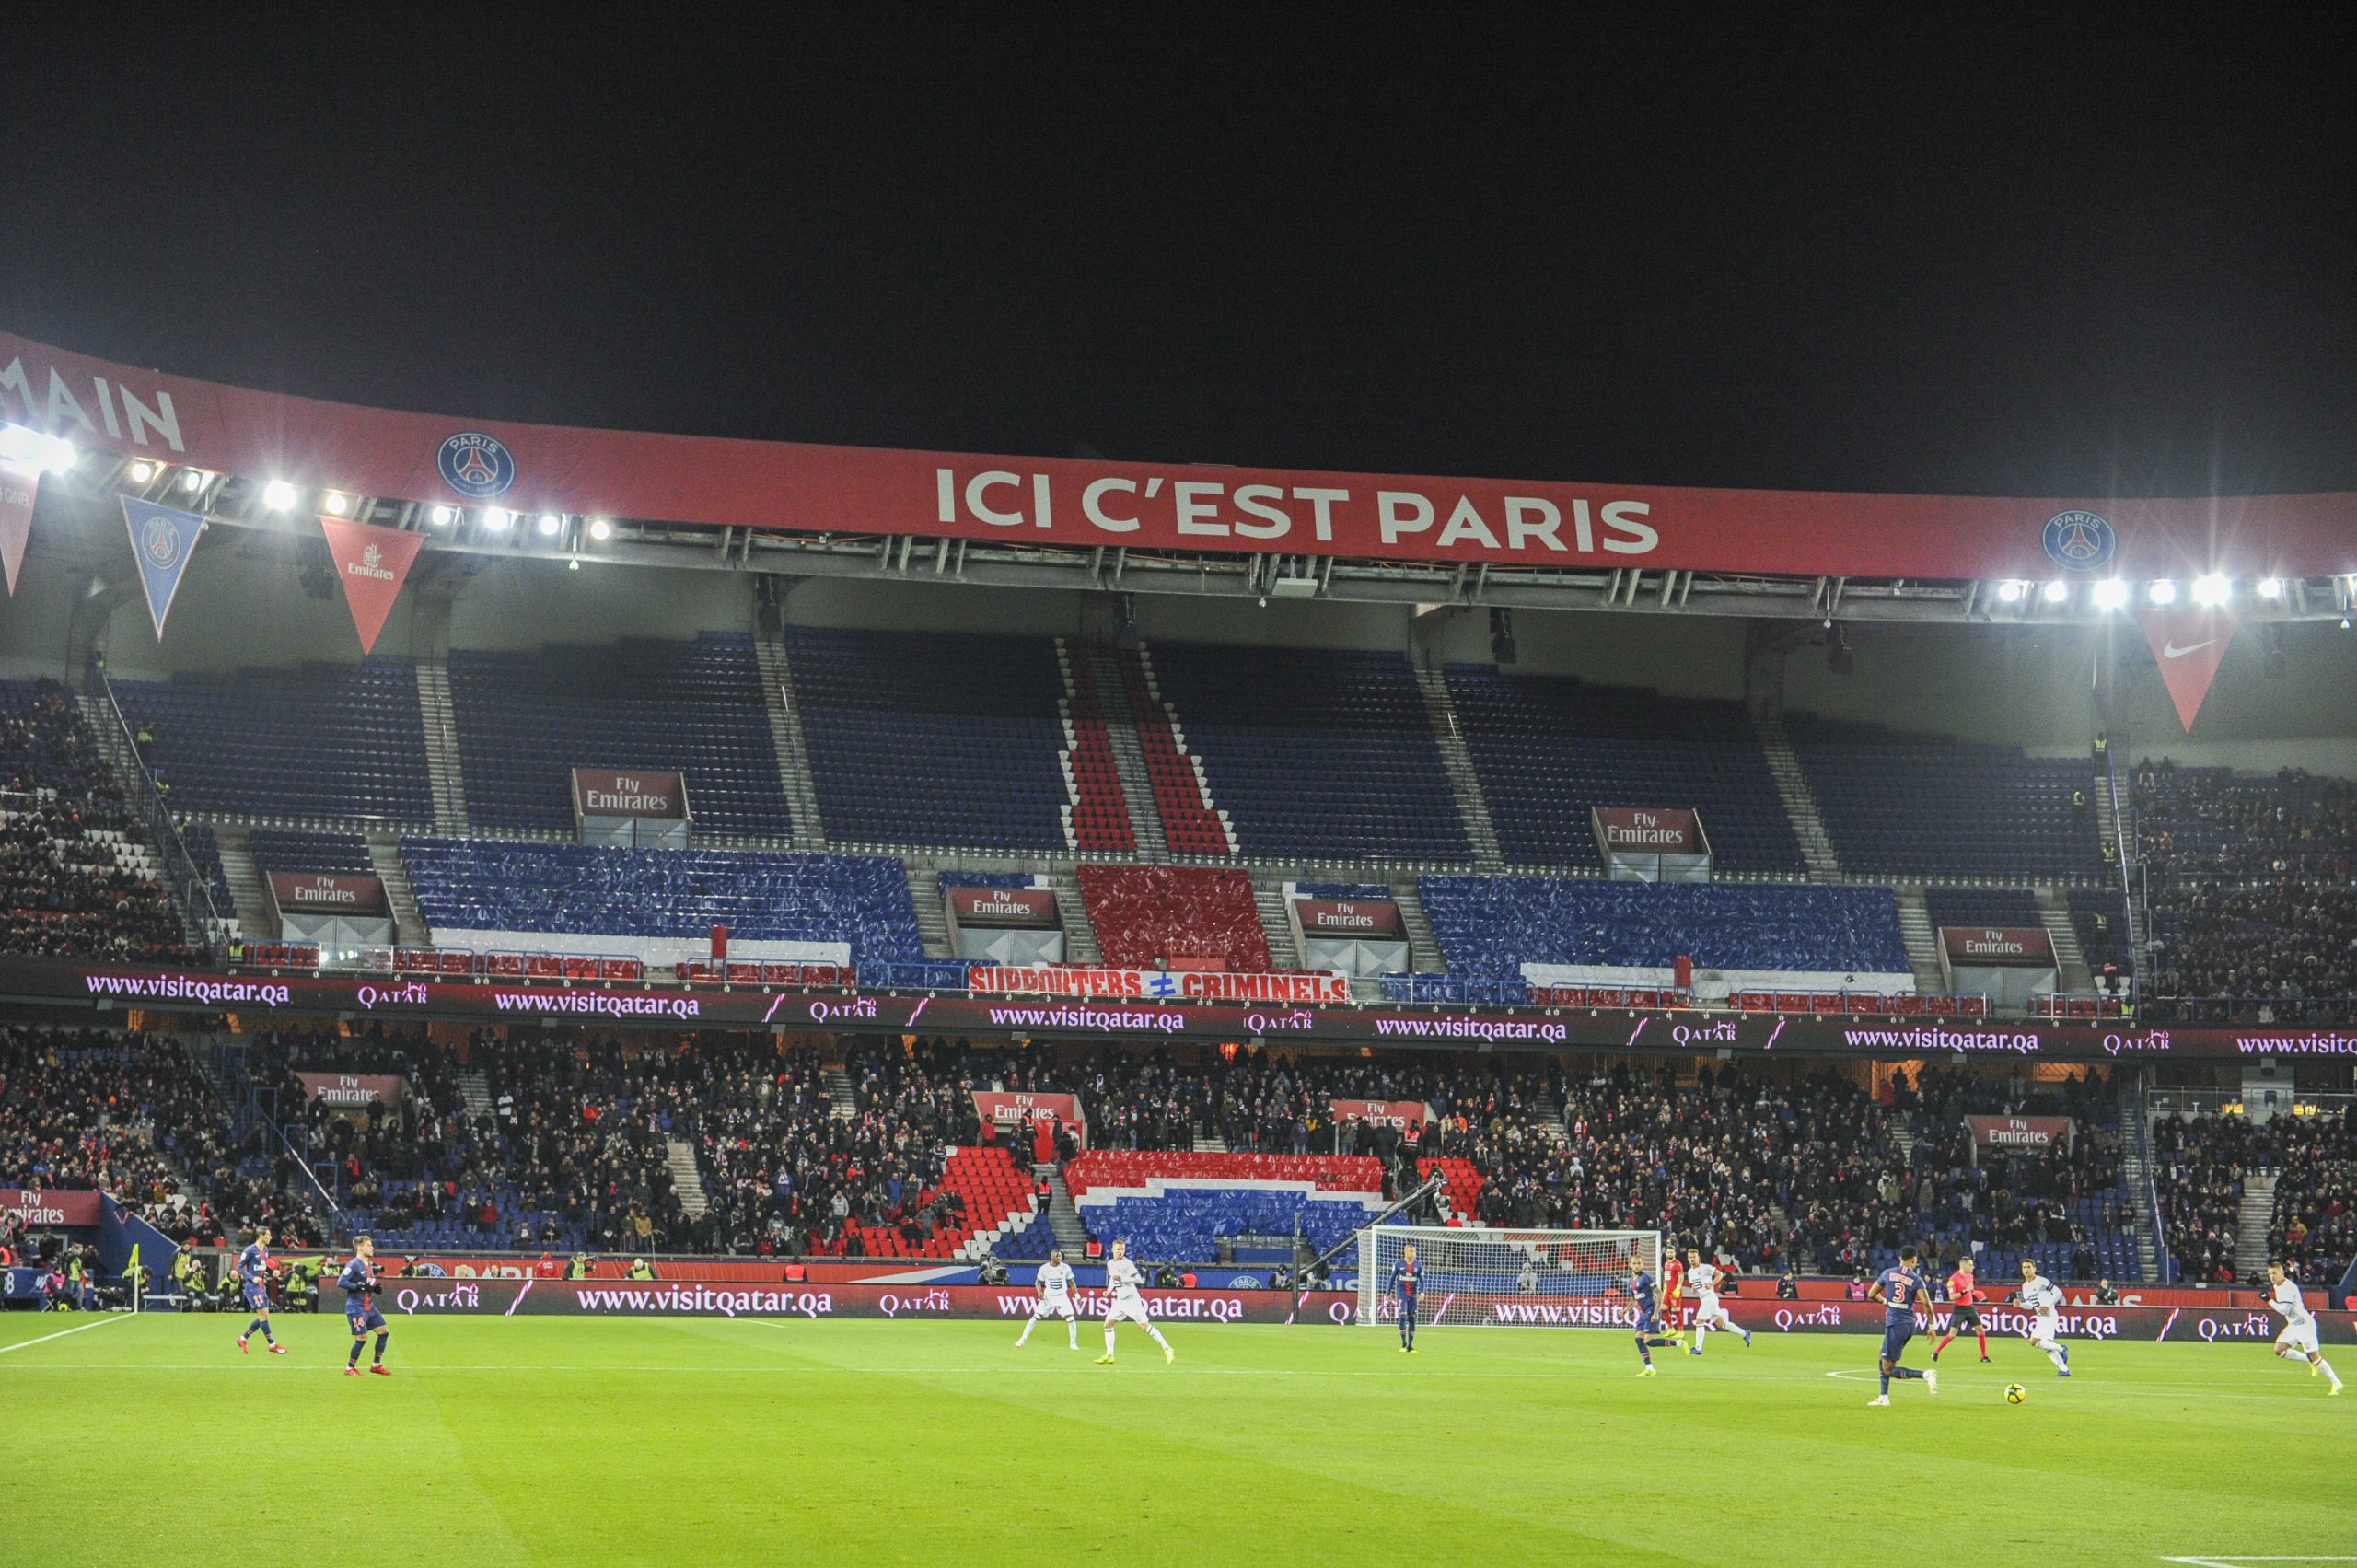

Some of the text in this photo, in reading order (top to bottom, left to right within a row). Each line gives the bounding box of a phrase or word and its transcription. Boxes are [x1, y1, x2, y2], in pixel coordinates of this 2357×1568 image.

[449, 436, 498, 454] PARIS
[936, 468, 1659, 554] ICI C'EST PARIS
[2054, 514, 2101, 529] PARIS
[348, 563, 394, 582] Emirates
[616, 777, 640, 794] Fly
[587, 790, 668, 811] Emirates
[1634, 813, 1656, 828] Fly
[1608, 825, 1683, 844] Emirates
[317, 877, 335, 889] Fly
[295, 886, 356, 902] Emirates
[994, 890, 1011, 902] Fly
[973, 900, 1031, 914] Emirates
[1337, 903, 1354, 914] Fly
[1318, 912, 1374, 927] Emirates
[1985, 930, 2003, 942] Fly
[1966, 939, 2023, 954] Emirates
[1182, 973, 1348, 1004] CRIMINELS
[340, 1075, 358, 1088] Fly
[318, 1086, 380, 1101] Emirate
[1016, 1095, 1034, 1106] Fly
[1367, 1102, 1385, 1115] Fly
[2010, 1119, 2027, 1131] Fly
[1989, 1129, 2049, 1143] Emirates
[21, 1191, 41, 1206] Fly
[1892, 1283, 1905, 1303] 3
